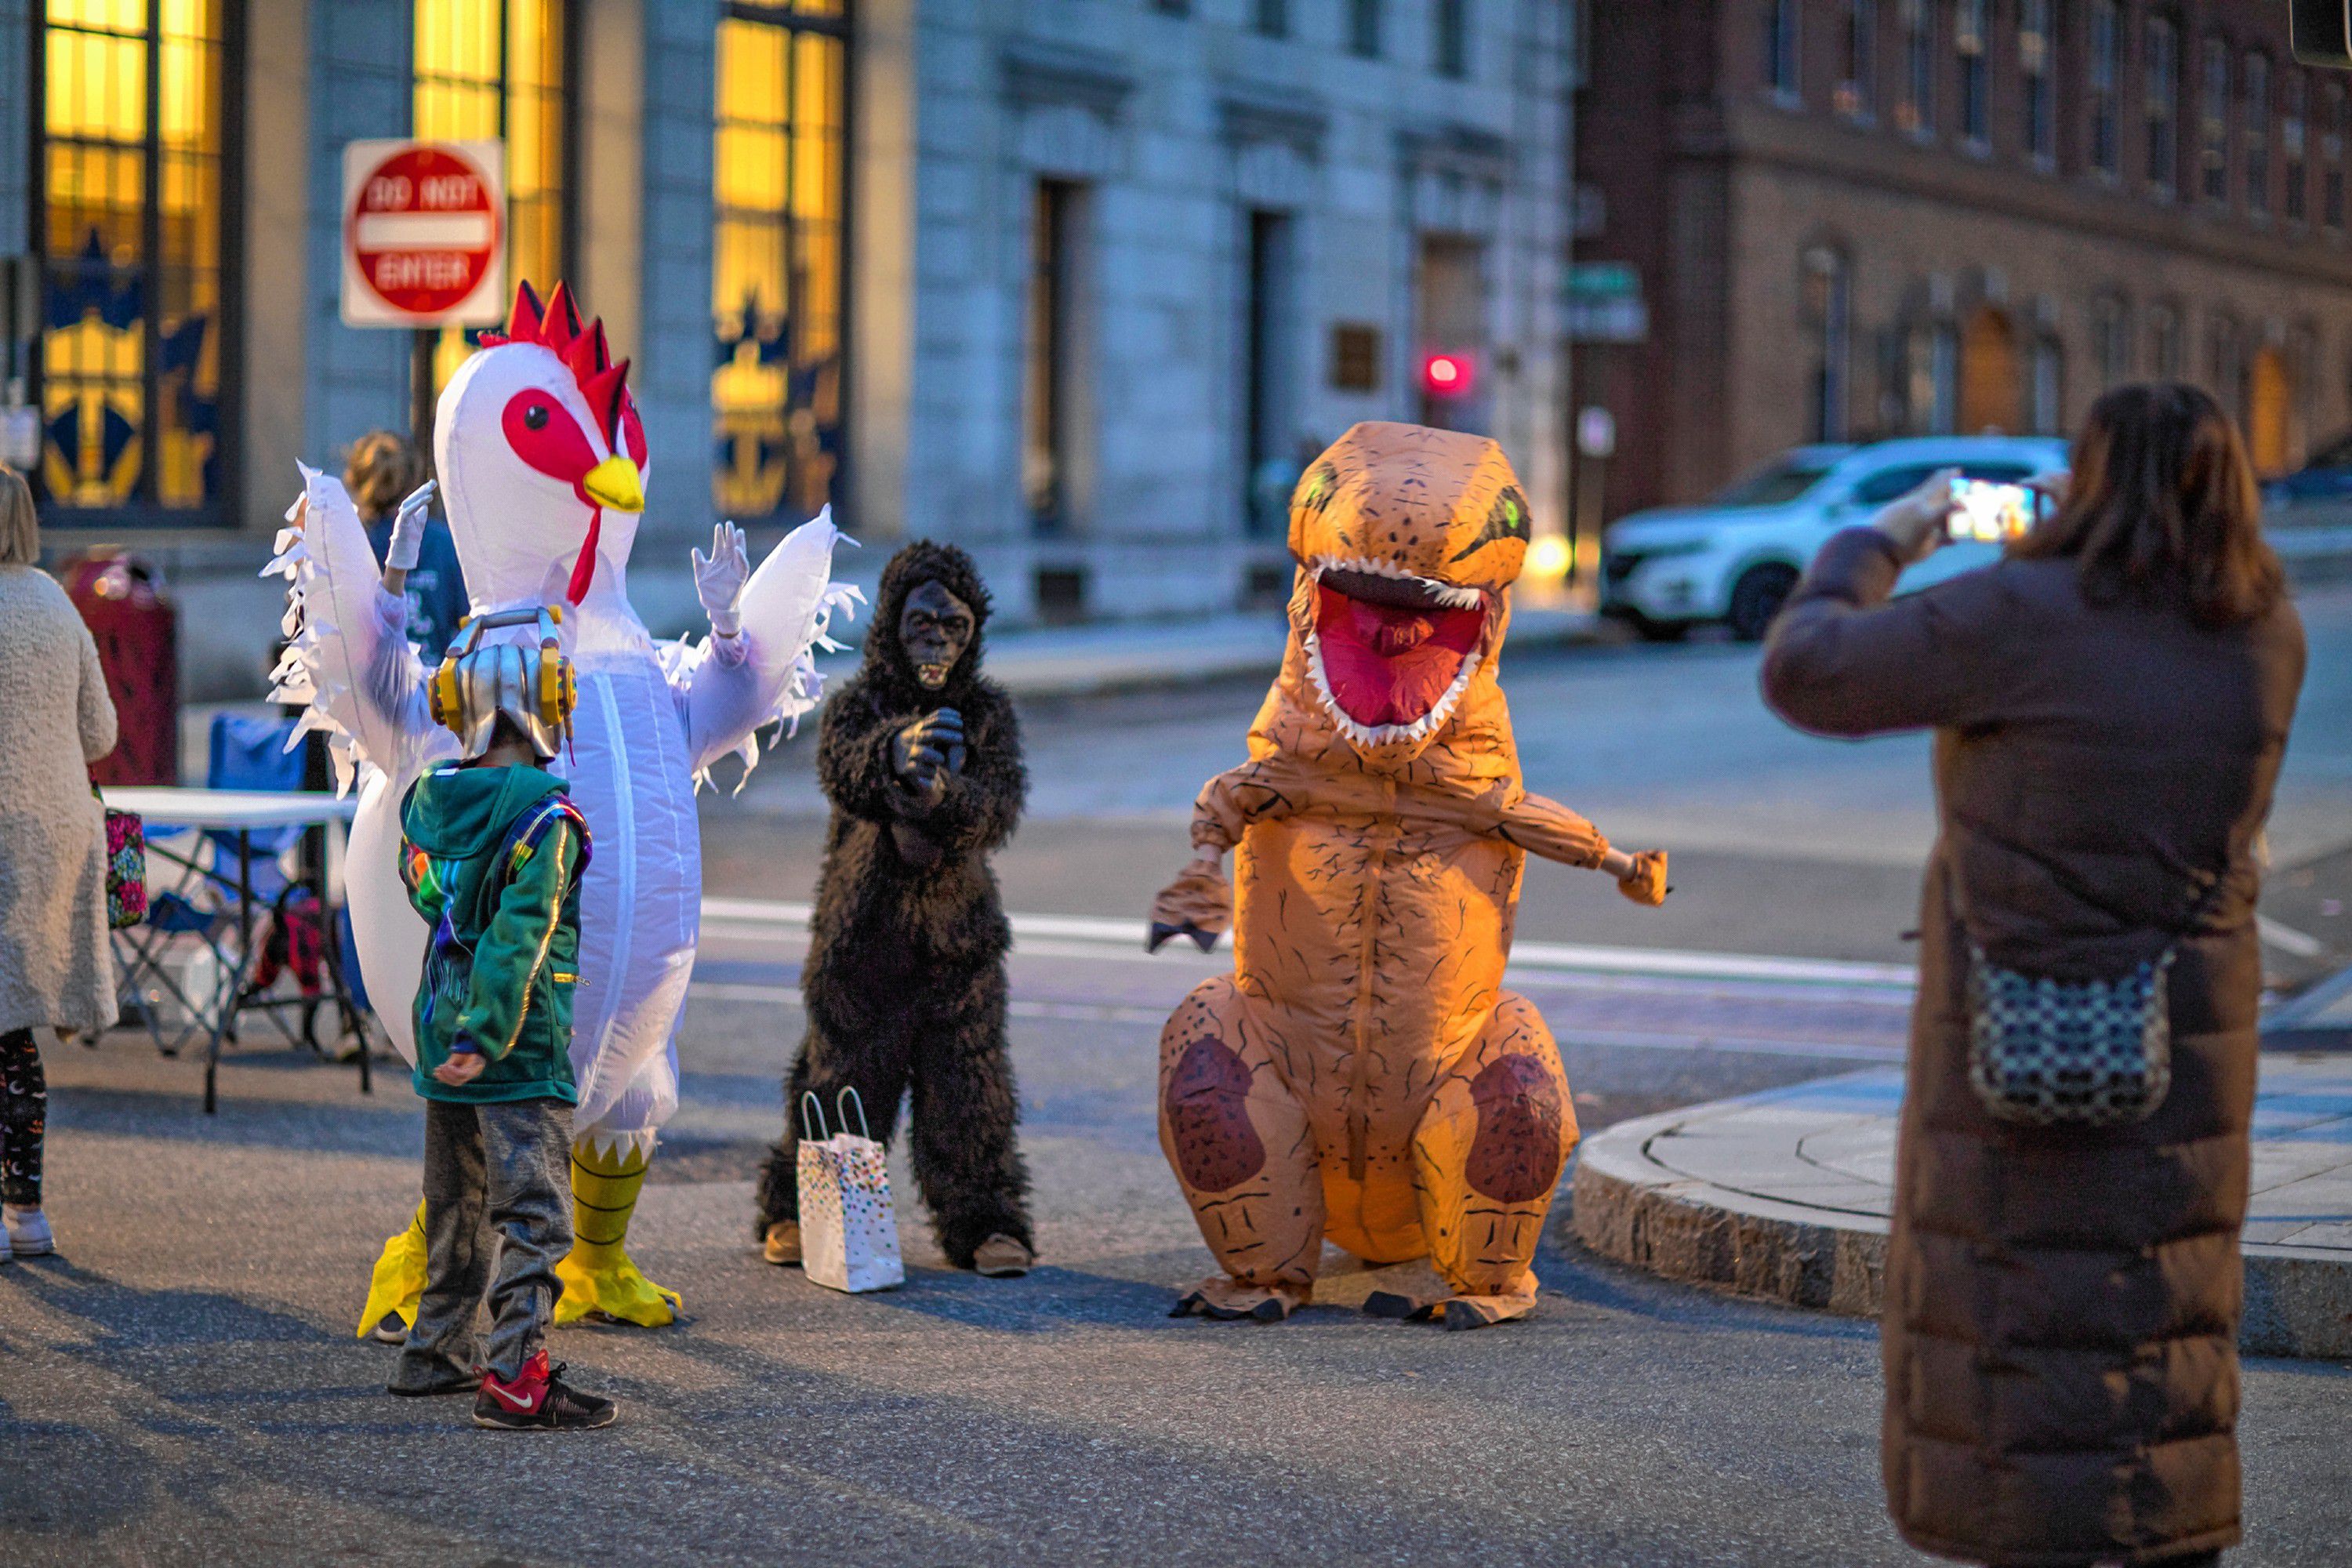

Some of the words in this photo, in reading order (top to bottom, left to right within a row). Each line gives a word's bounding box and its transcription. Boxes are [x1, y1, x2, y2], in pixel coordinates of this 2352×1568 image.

[367, 176, 412, 210] DO
[419, 175, 478, 209] NOT
[376, 253, 470, 290] ENTER
